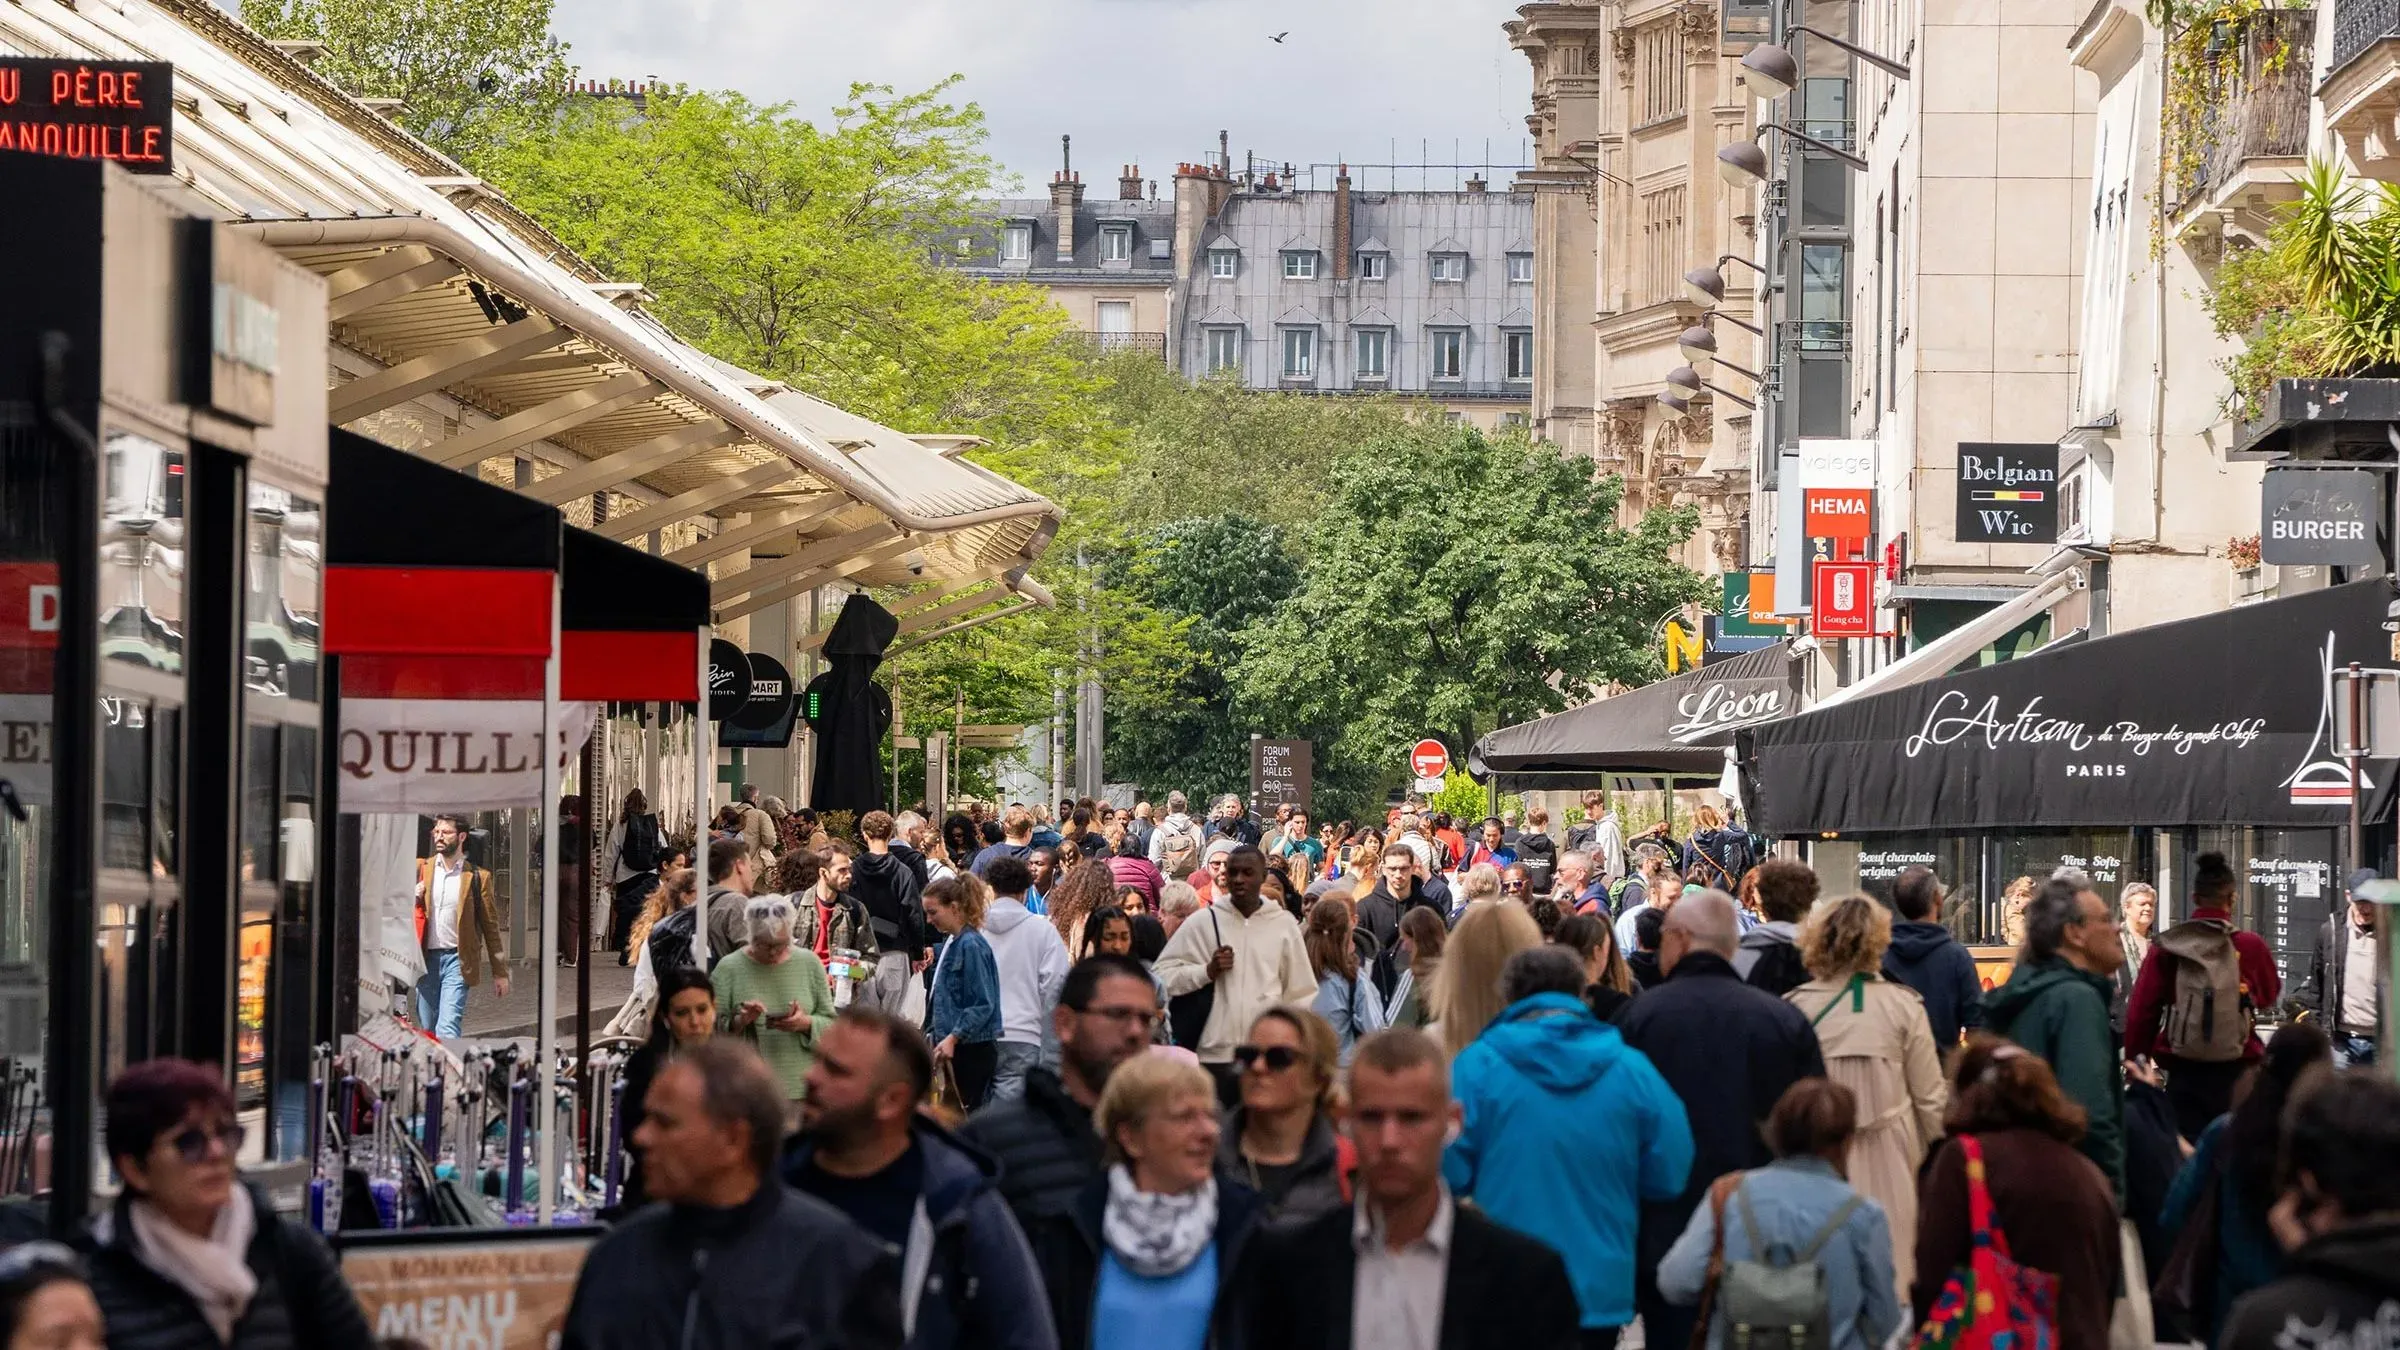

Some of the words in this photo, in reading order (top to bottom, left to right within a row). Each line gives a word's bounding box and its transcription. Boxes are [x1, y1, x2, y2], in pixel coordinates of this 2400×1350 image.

[53, 65, 143, 108] PÈRE
[1962, 455, 2054, 486] Belgian
[1811, 498, 1866, 515] HEMA
[1978, 510, 2034, 535] Wic
[2272, 520, 2365, 540] BURGER
[1823, 614, 1847, 625] Gong
[1847, 614, 1864, 624] cha
[1906, 691, 2092, 757] L'Artisan
[2098, 725, 2113, 742] du
[2116, 721, 2164, 756] Burger
[2221, 718, 2266, 749] Chefs
[1263, 746, 1290, 756] FORUM
[1263, 756, 1278, 766] DES
[1263, 767, 1293, 777] HALLES
[2066, 765, 2127, 777] PARIS
[1886, 852, 1936, 863] charolais
[2061, 855, 2087, 866] Vins
[2092, 855, 2120, 869] Softs
[1859, 866, 1897, 880] origine
[2095, 871, 2117, 882] Thé
[376, 1290, 518, 1338] MENU
